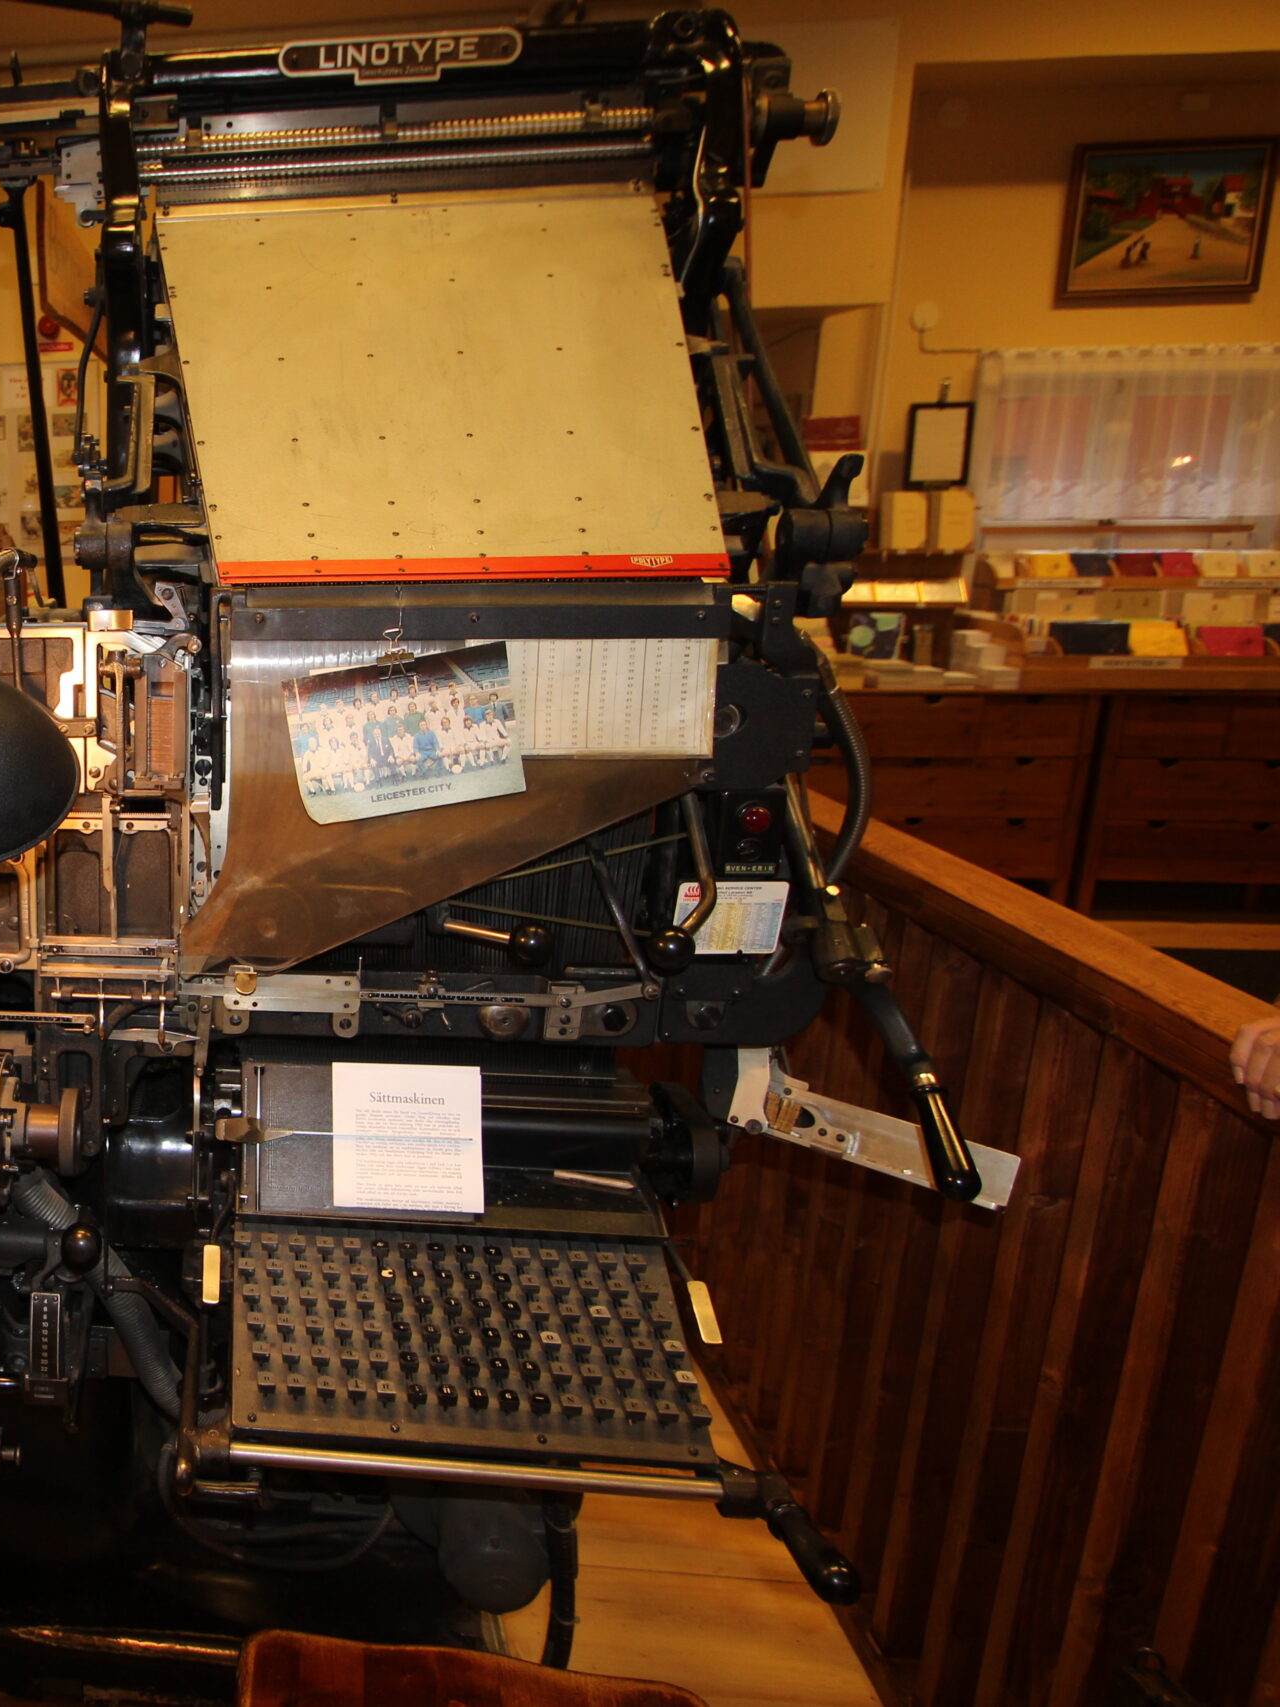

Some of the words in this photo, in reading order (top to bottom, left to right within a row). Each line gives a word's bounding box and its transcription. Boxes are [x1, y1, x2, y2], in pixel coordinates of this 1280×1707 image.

[319, 36, 479, 69] LINOTYPE
[371, 787, 426, 803] LEICESTER
[428, 783, 452, 794] CITY
[369, 1091, 445, 1105] Sättmaskinen
